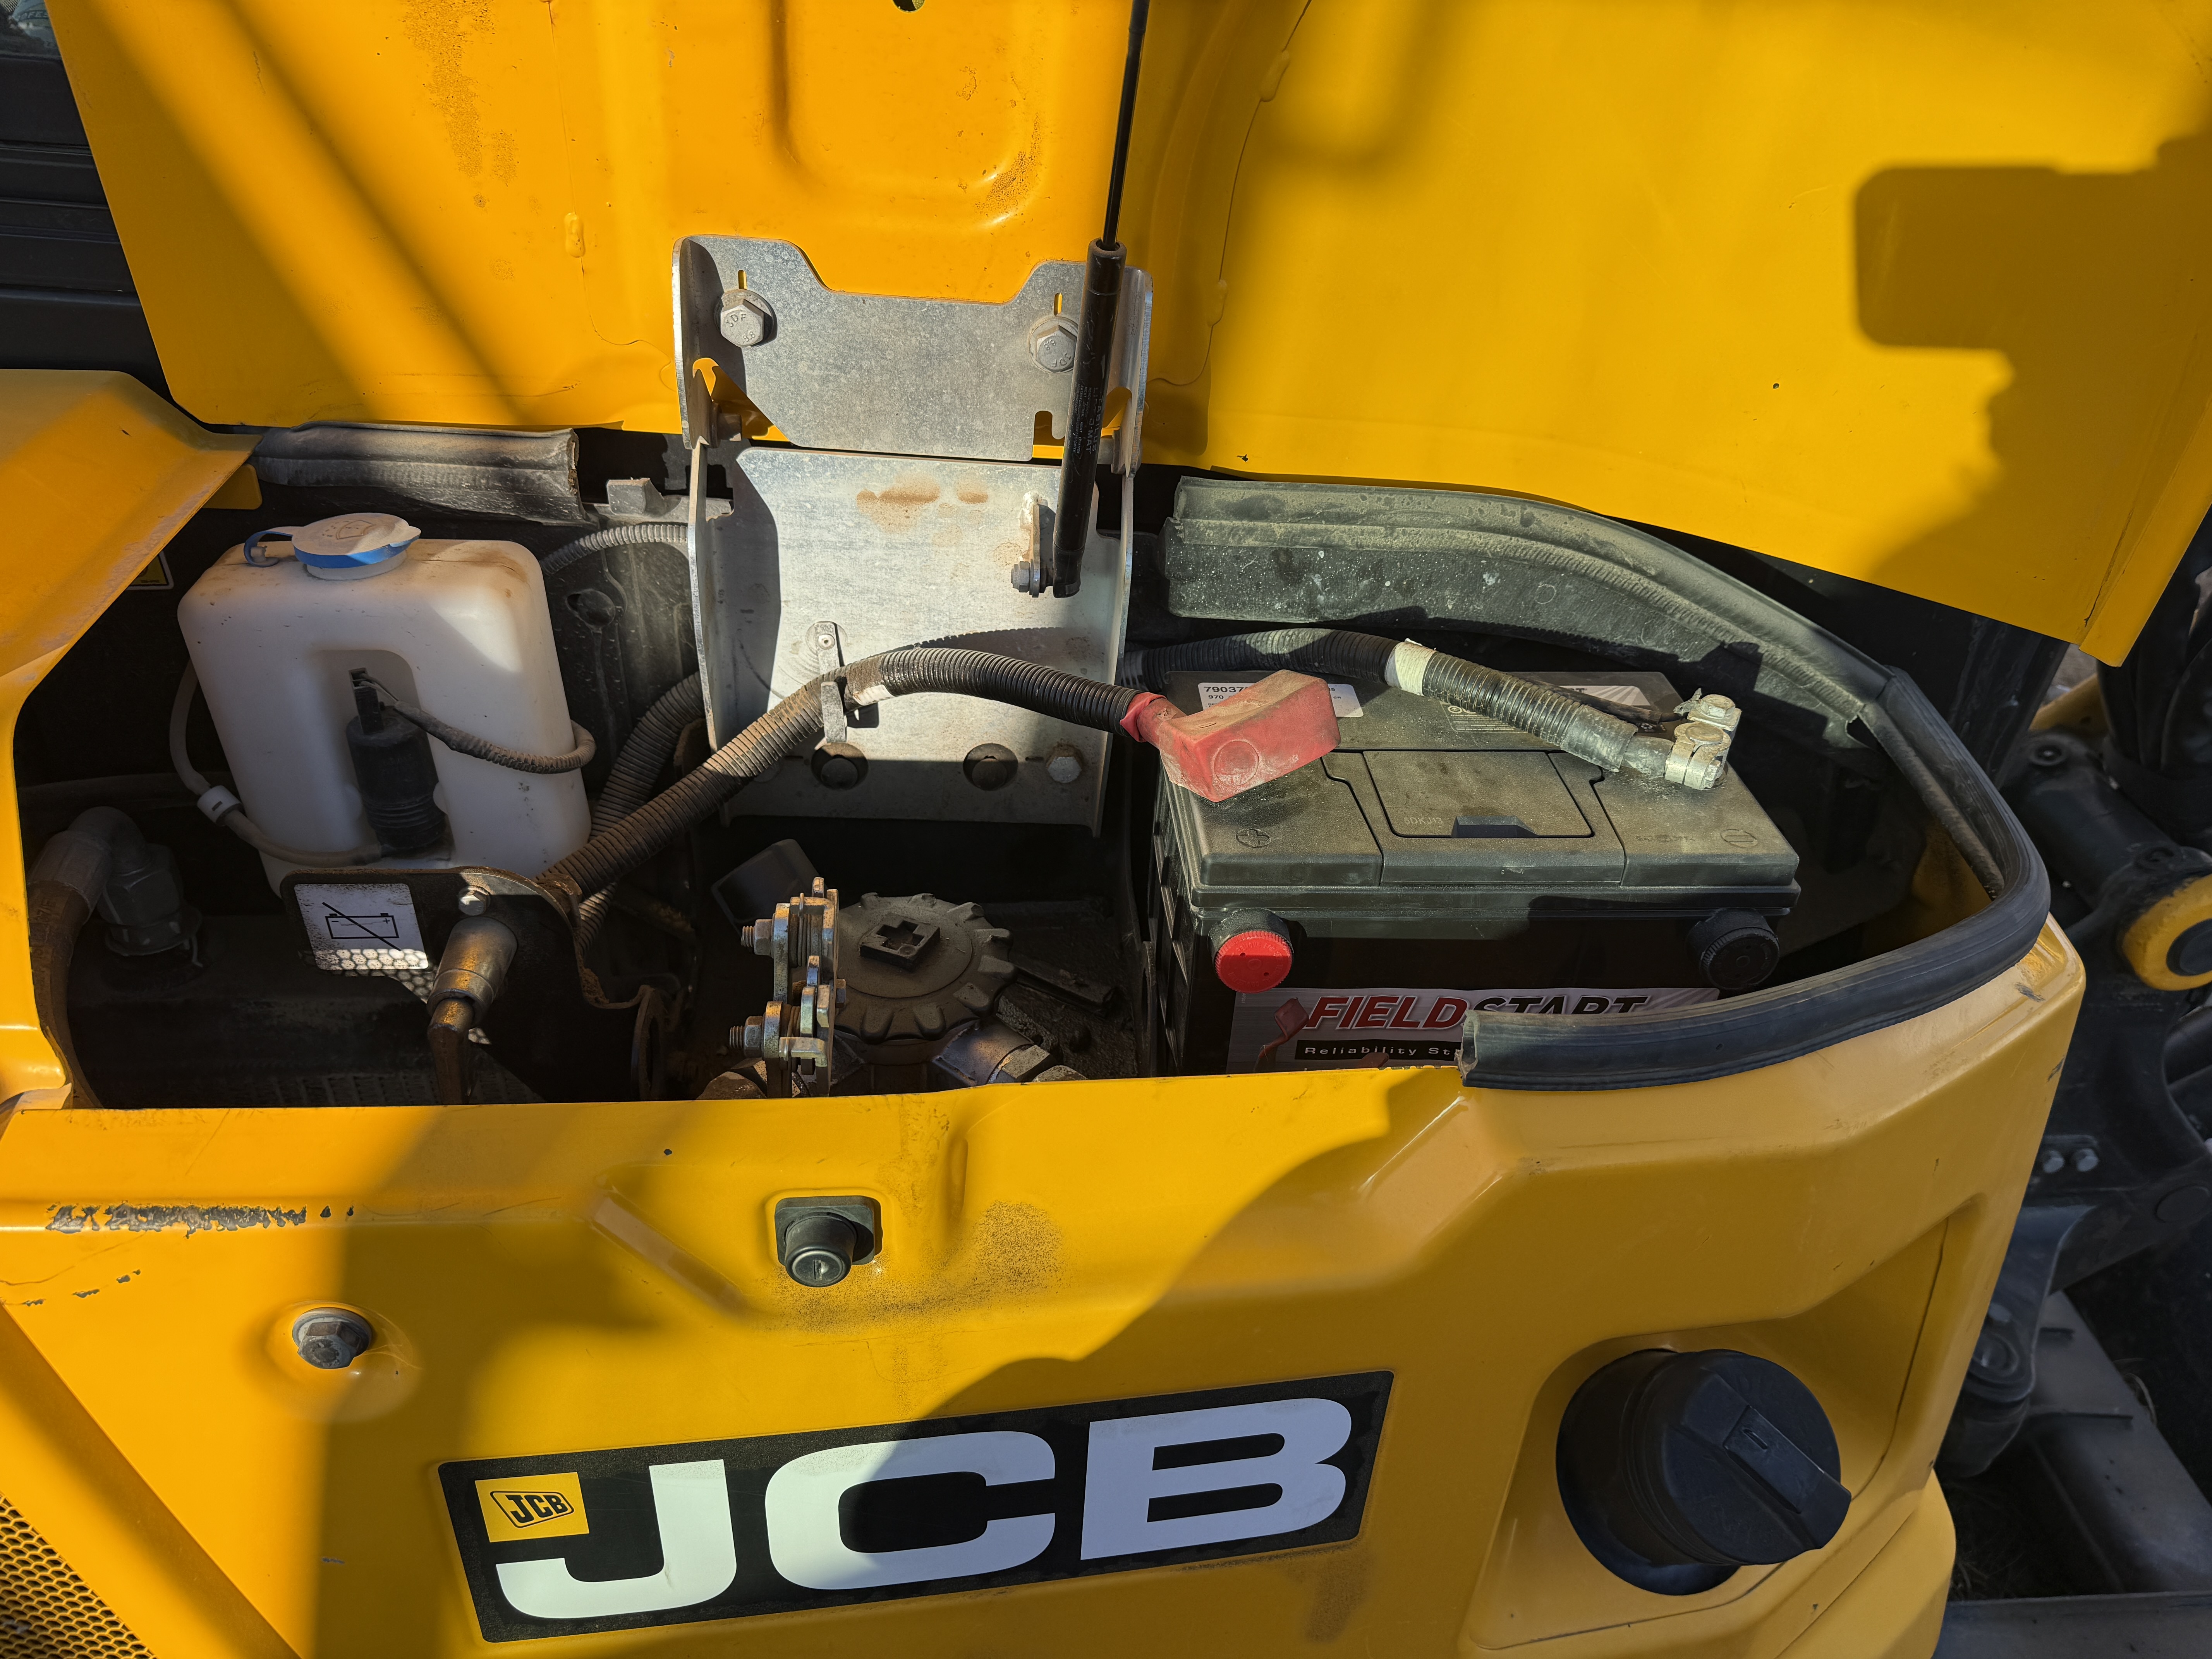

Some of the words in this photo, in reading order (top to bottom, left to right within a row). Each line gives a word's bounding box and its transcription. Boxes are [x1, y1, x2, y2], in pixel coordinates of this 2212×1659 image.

[1091, 389, 1105, 452] TABILUS
[1304, 1046, 1417, 1056] Reliability
[495, 1398, 1352, 1619] JCB
[505, 1495, 568, 1523] JCB
